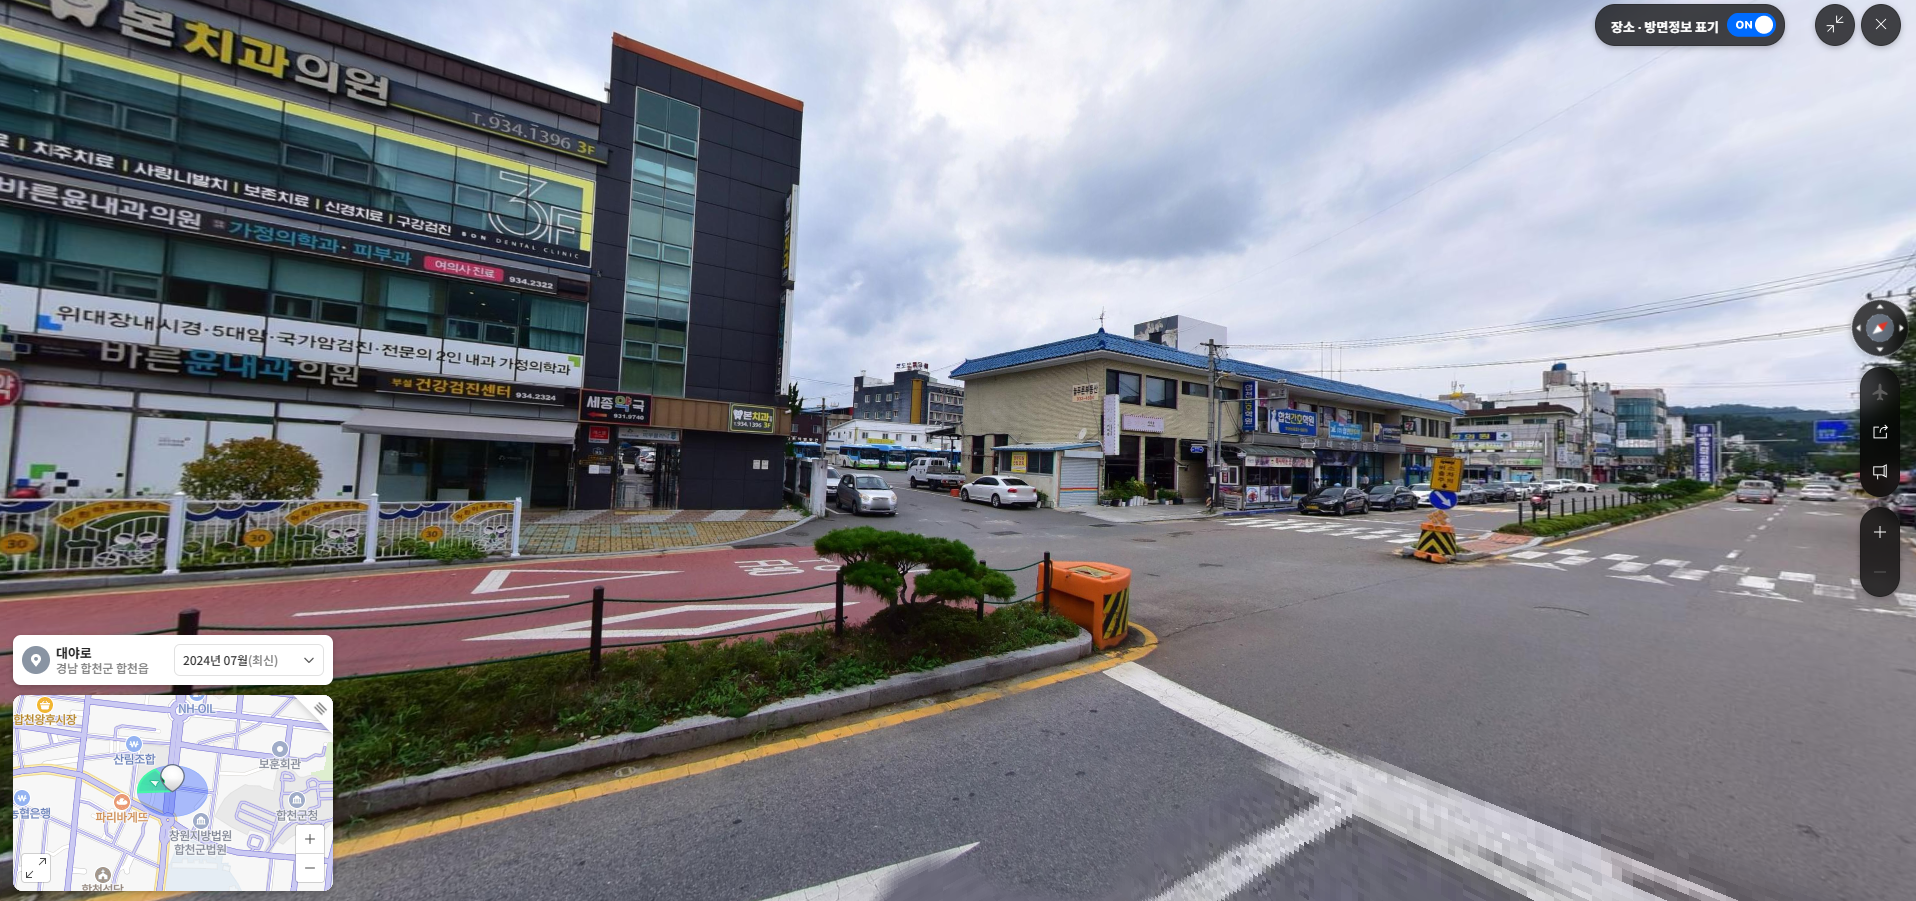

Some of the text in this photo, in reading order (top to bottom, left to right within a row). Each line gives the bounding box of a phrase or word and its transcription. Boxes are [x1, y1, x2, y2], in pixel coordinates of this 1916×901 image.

[118, 0, 390, 106] 본치과의원
[576, 139, 596, 155] 3F
[33, 139, 116, 171] 치주치료
[134, 161, 229, 193] 사랑니발치
[243, 181, 310, 209] 보존치료
[324, 201, 384, 224] 신경치료
[396, 214, 452, 238] 구강검진
[0, 175, 202, 230] 바른윤내과의원
[487, 170, 583, 249] 3F
[352, 242, 413, 266] 피부과
[461, 230, 579, 260] BON DENTAL CLINIC
[434, 261, 496, 280] 여의사 진료
[508, 275, 554, 290] 934.2322
[99, 340, 361, 388] 바른윤내과의원
[436, 350, 461, 365] 2인
[464, 352, 496, 369] 내과
[499, 356, 571, 377] 가정의학과
[415, 377, 512, 399] 건강검진센터
[515, 391, 557, 402] 934.2324
[586, 394, 646, 414] 세종약국
[1277, 411, 1315, 427] 합천간호학원
[250, 533, 267, 542] 30
[425, 530, 439, 538] 30
